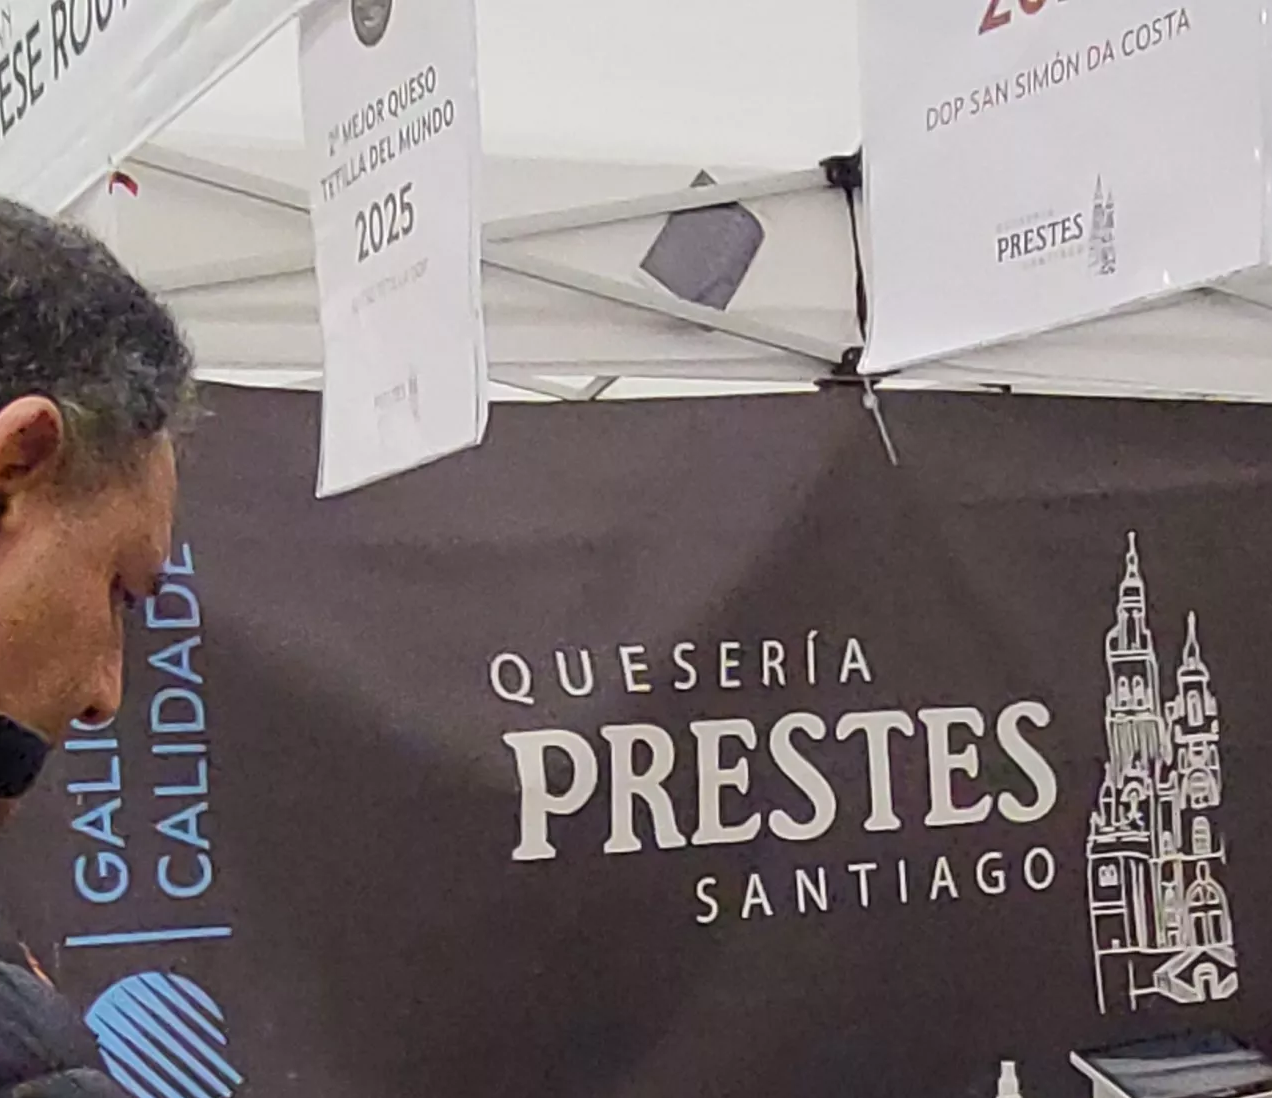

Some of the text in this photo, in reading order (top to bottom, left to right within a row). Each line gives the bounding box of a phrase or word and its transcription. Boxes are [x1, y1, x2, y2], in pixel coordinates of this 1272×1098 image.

[342, 98, 385, 144] MEJOR
[388, 65, 436, 119] QUESO
[926, 8, 1192, 132] DOP SAN SIMÓN DA COSTA
[369, 135, 396, 171] DEL
[399, 99, 455, 153] MUNDO
[354, 181, 415, 264] 2025
[997, 212, 1083, 263] PRESTES
[489, 630, 873, 704] QUESERÍA
[64, 716, 129, 904] GALI
[503, 701, 1058, 860] PRESTES
[696, 847, 1056, 925] SANTIAGO
